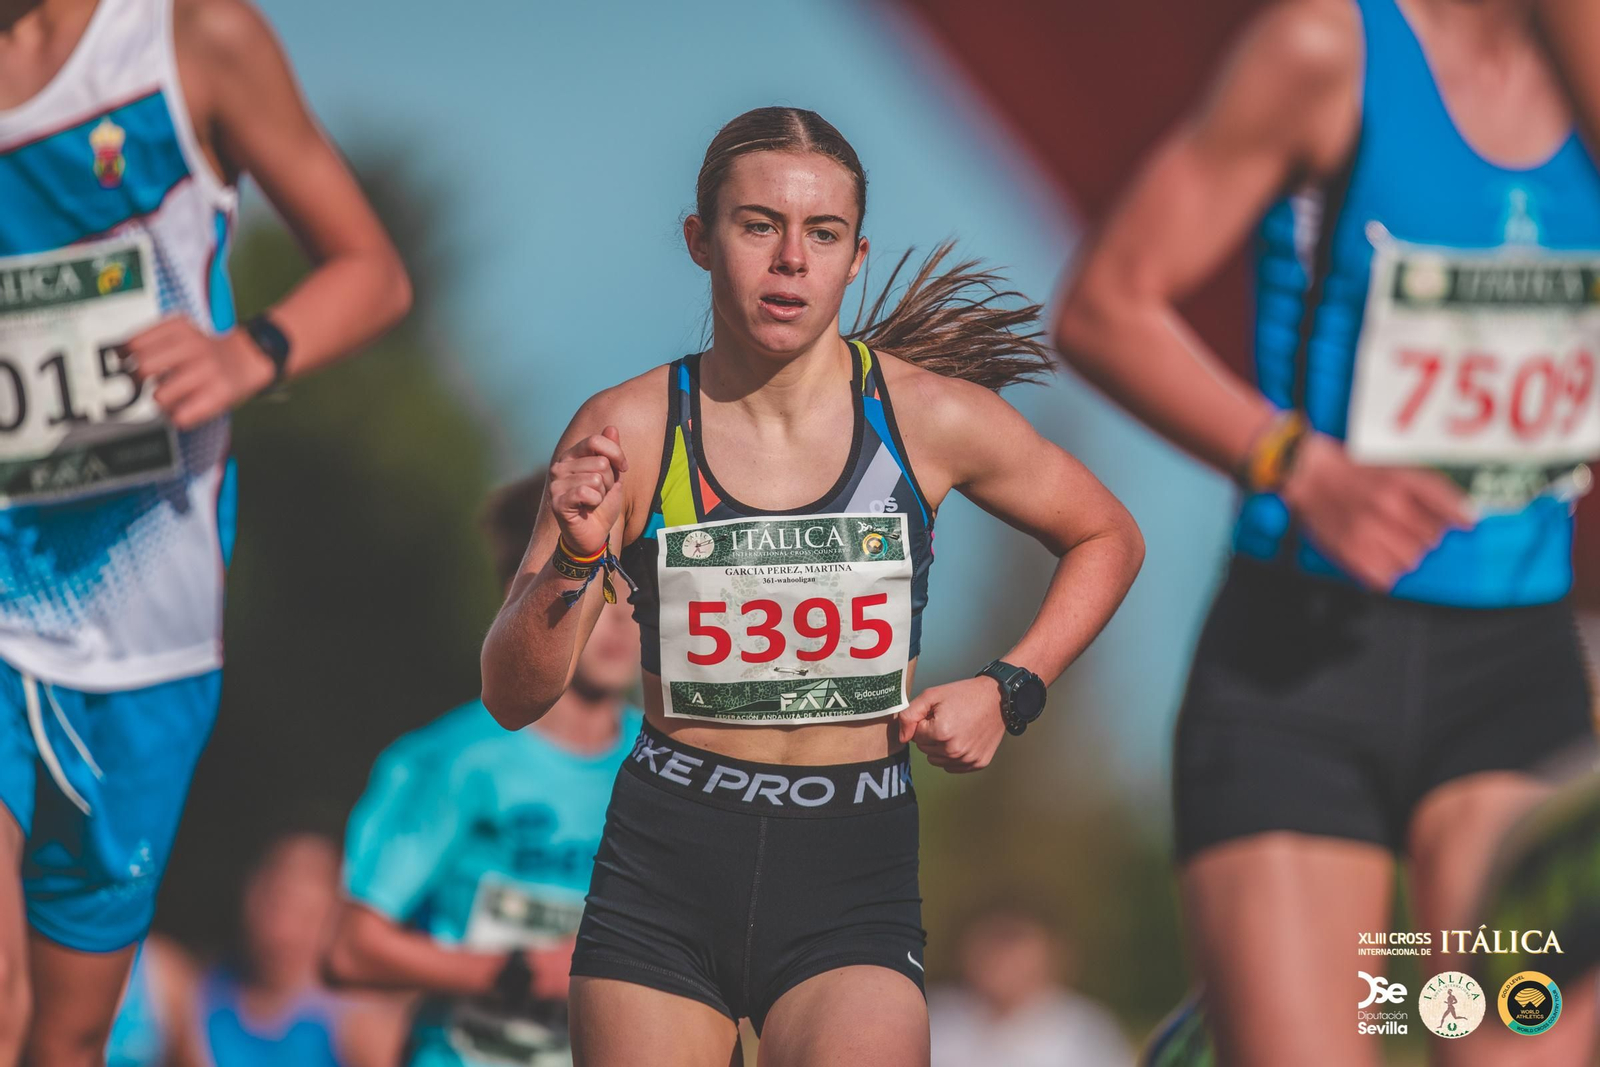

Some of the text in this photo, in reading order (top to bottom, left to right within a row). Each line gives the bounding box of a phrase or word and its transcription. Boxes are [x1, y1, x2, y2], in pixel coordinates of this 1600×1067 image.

[0, 265, 82, 305] LICA
[1391, 346, 1597, 440] 7509
[731, 523, 845, 551] ITÁLICA
[725, 565, 852, 576] GARCIA PEREZ, MARTINA
[687, 592, 893, 666] 5395
[862, 686, 896, 698] docunova
[714, 712, 759, 721] FEDERACIÓN
[762, 713, 800, 721] ANDALUZA
[815, 709, 855, 718] ATLETISMO
[702, 765, 836, 807] PRO
